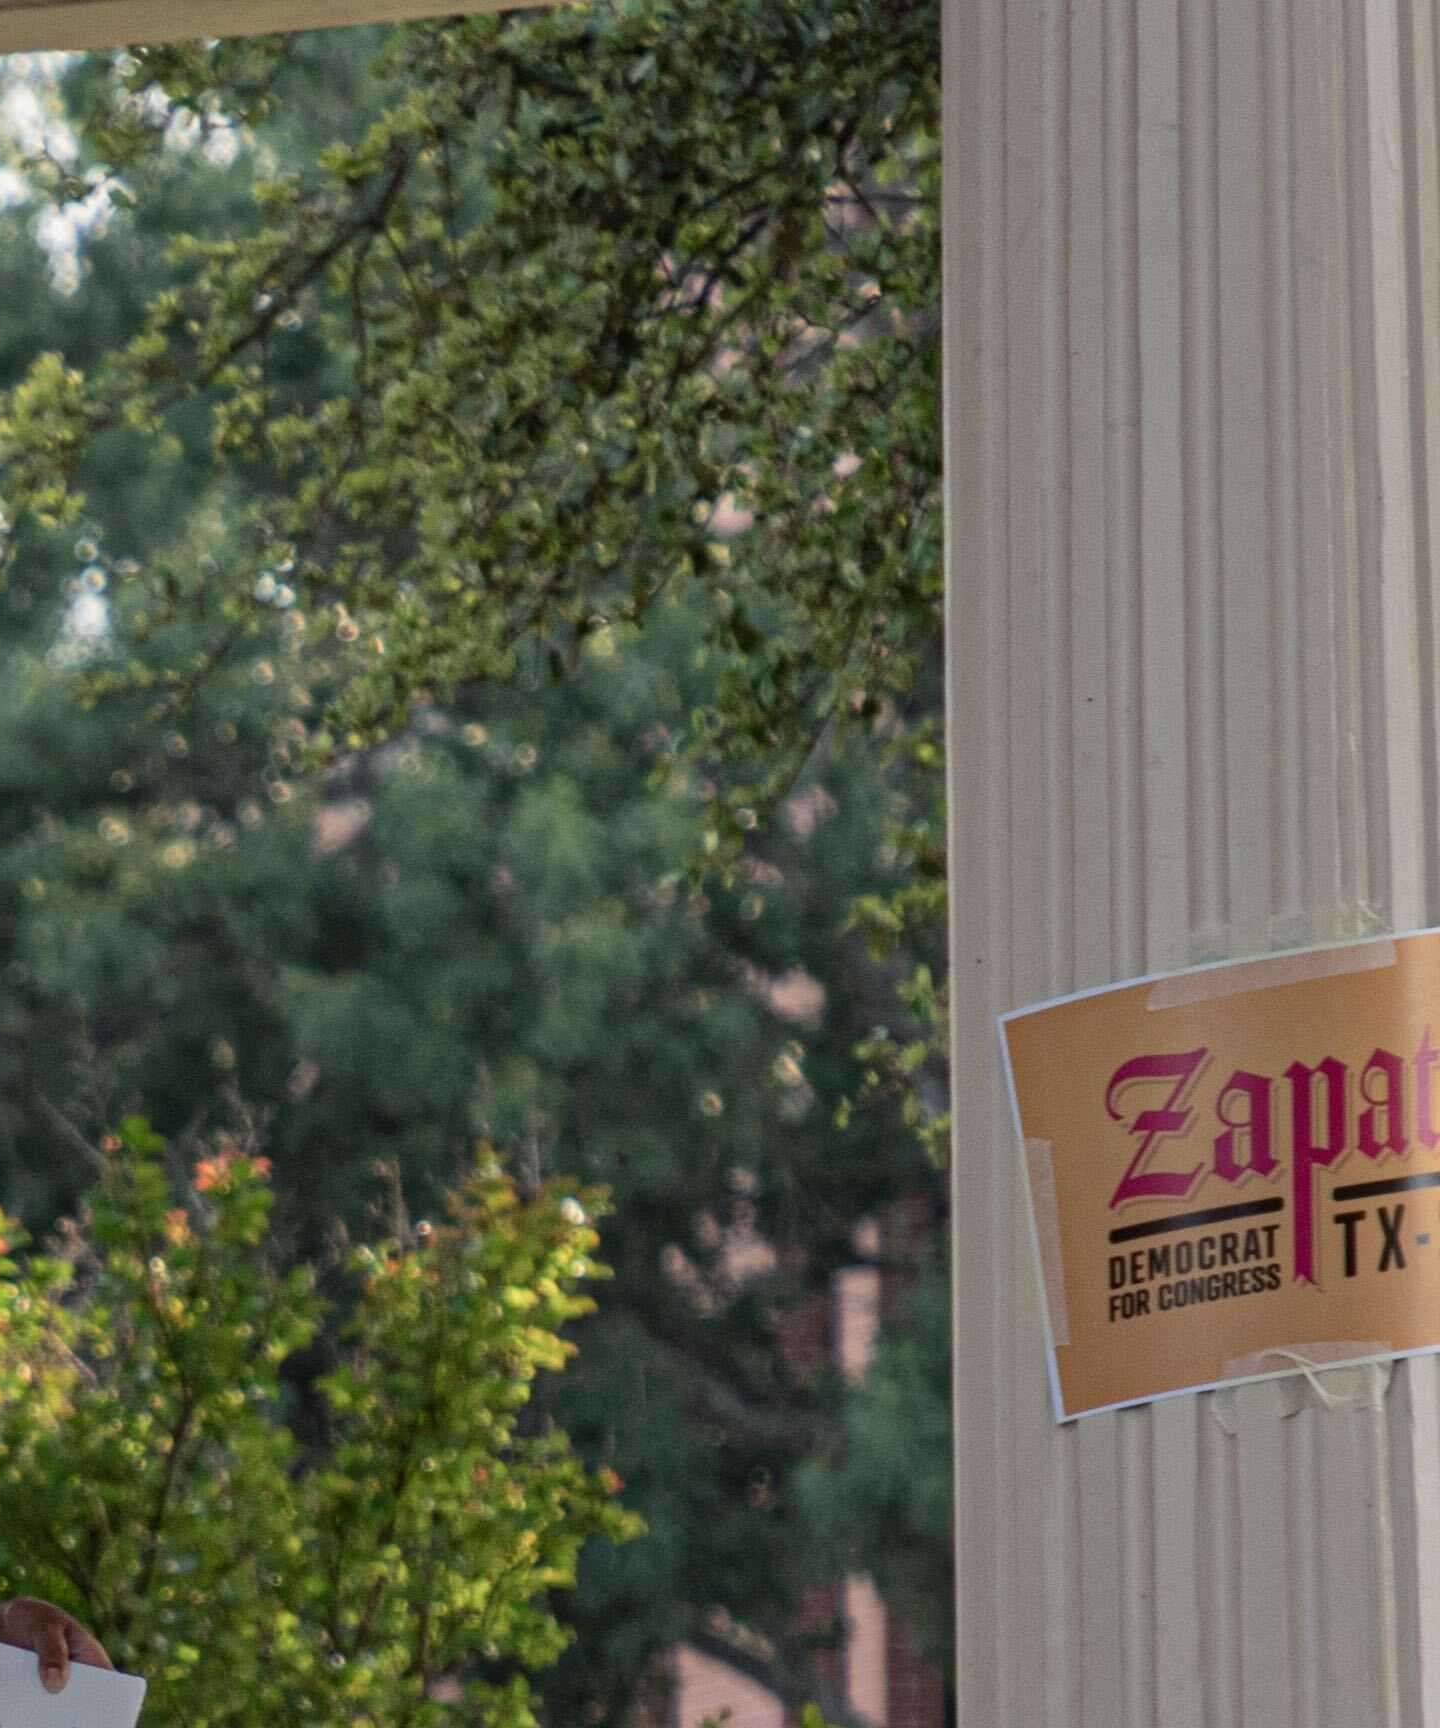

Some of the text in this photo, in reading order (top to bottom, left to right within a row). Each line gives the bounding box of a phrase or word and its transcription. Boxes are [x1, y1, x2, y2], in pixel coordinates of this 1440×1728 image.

[1108, 1224, 1280, 1290] DEMOCRAT
[1108, 1263, 1281, 1322] FOR CONGRESS
